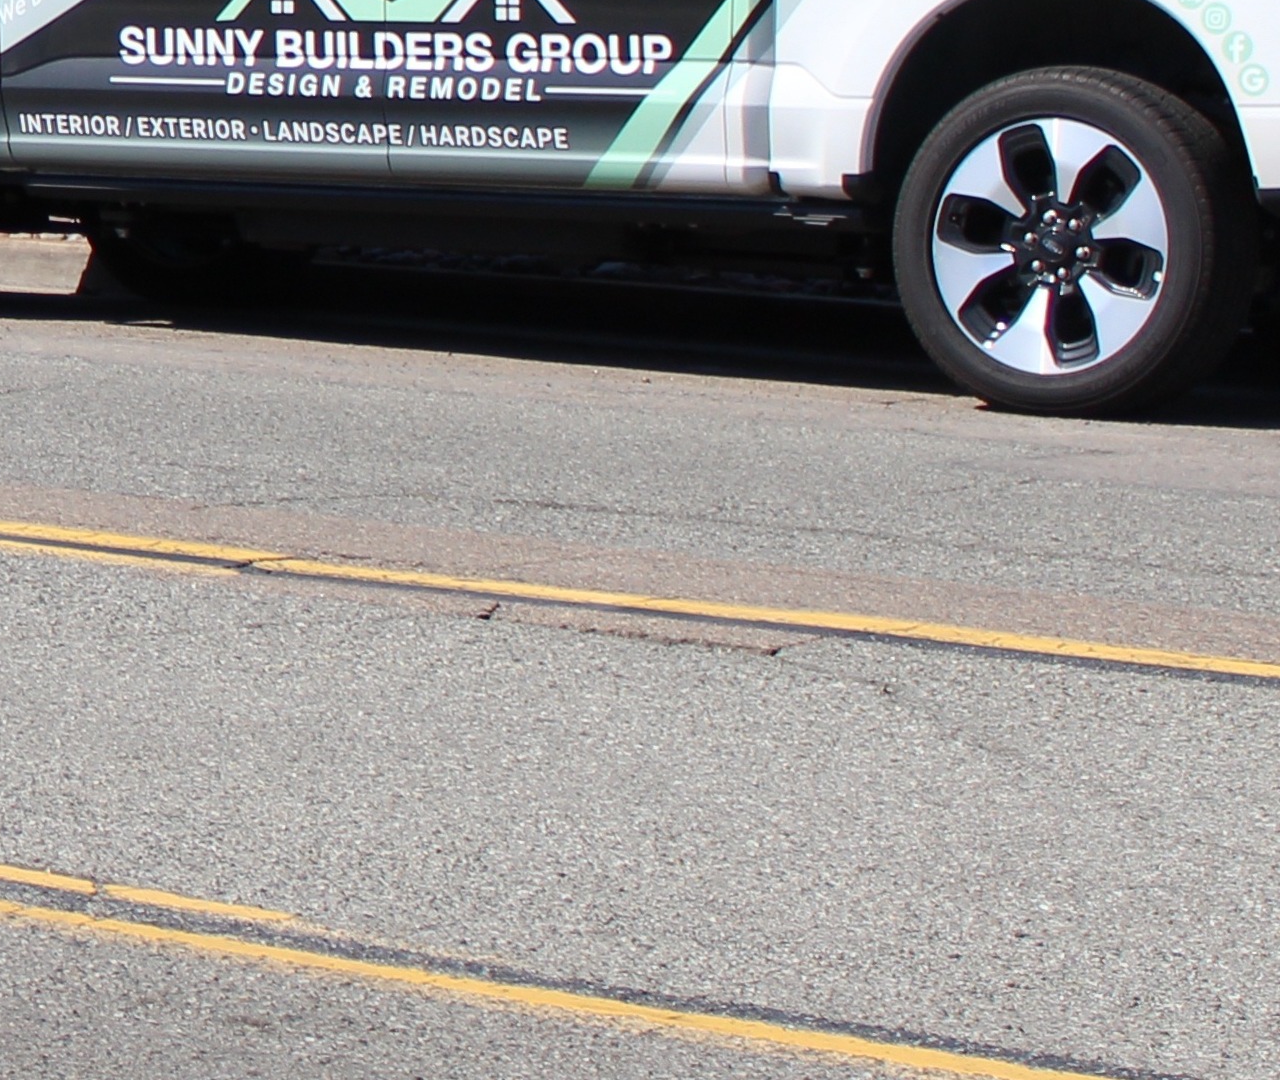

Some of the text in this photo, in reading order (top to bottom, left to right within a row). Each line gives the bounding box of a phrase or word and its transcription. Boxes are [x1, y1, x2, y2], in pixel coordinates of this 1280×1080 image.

[0, 0, 26, 25] We
[119, 25, 673, 75] SUNNY BUILDERS GROUP
[226, 72, 542, 101] DESIGN & REMODEL
[19, 113, 120, 136] INTERIOR
[137, 117, 246, 140] EXTERIOR
[263, 121, 403, 146] LANDSCAPE
[420, 125, 568, 151] HARDSCAPE
